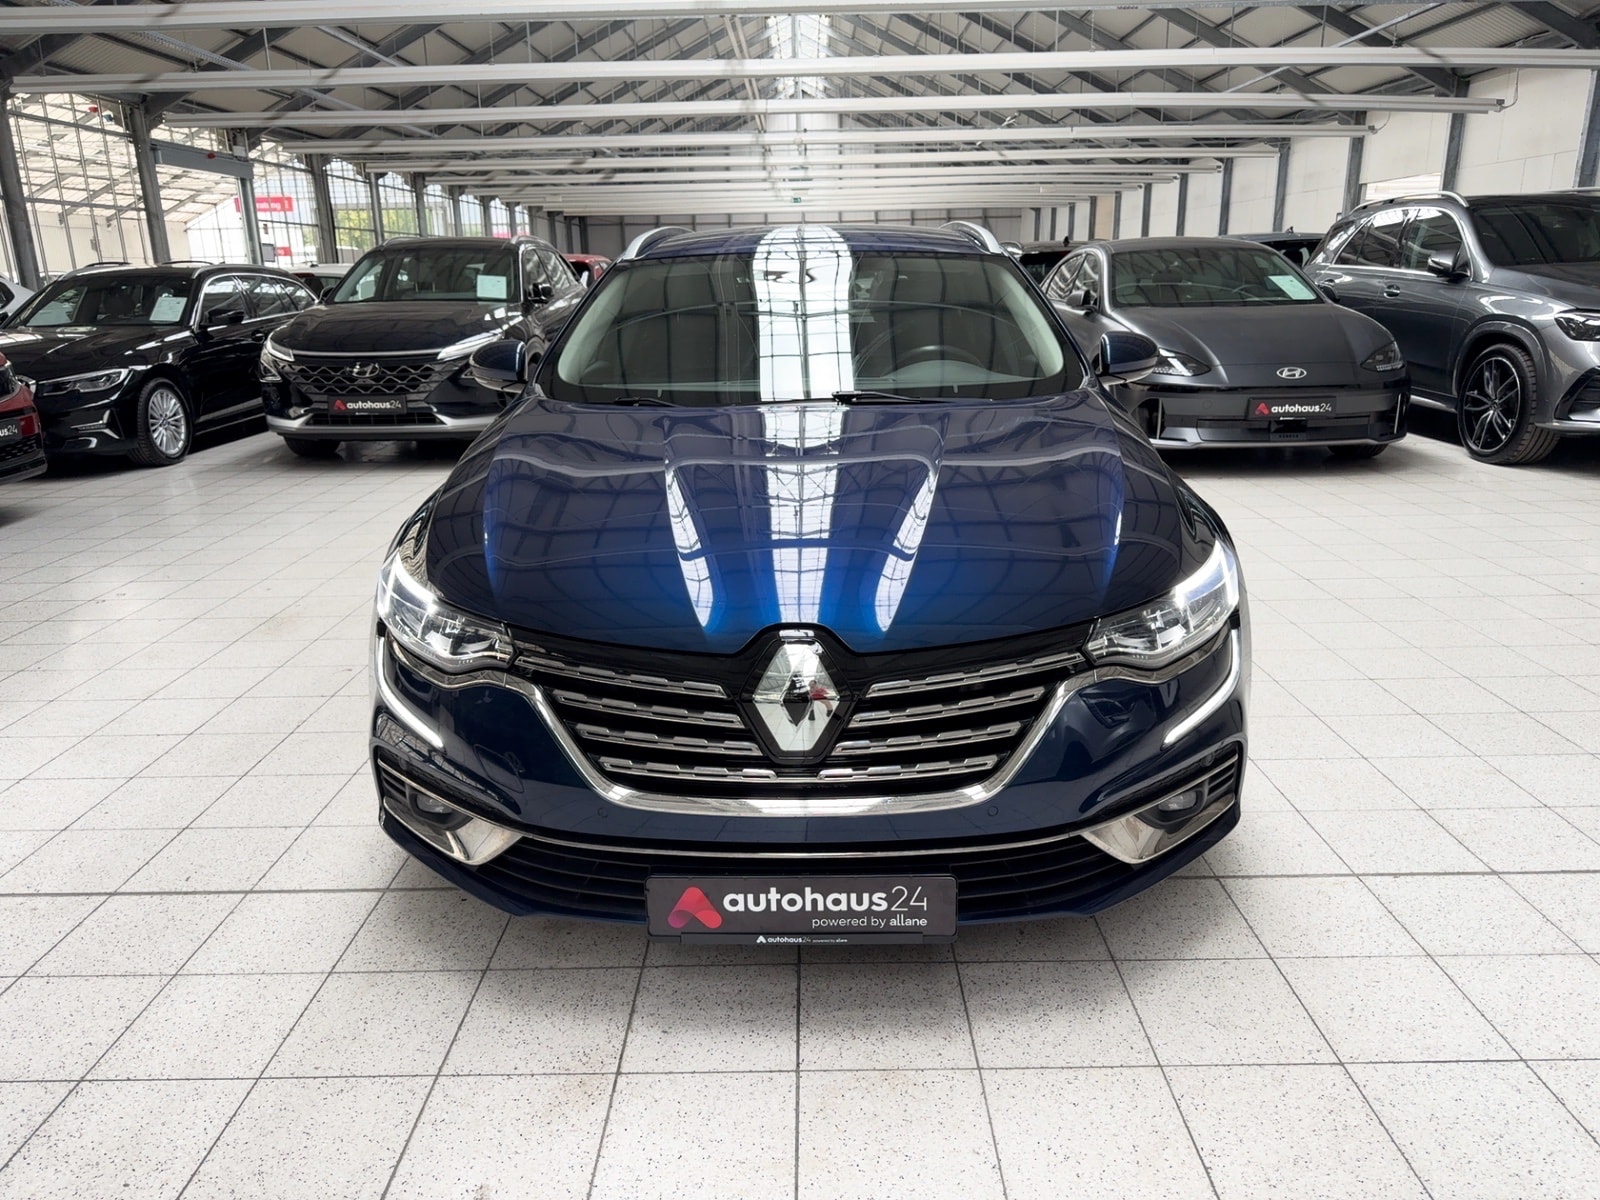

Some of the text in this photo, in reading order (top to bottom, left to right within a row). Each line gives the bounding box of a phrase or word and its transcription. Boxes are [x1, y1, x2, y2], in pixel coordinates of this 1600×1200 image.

[346, 400, 402, 409] autohaus24
[1271, 403, 1332, 413] autohaus24
[722, 886, 928, 912] autohaus24
[812, 914, 928, 929] powered by allane
